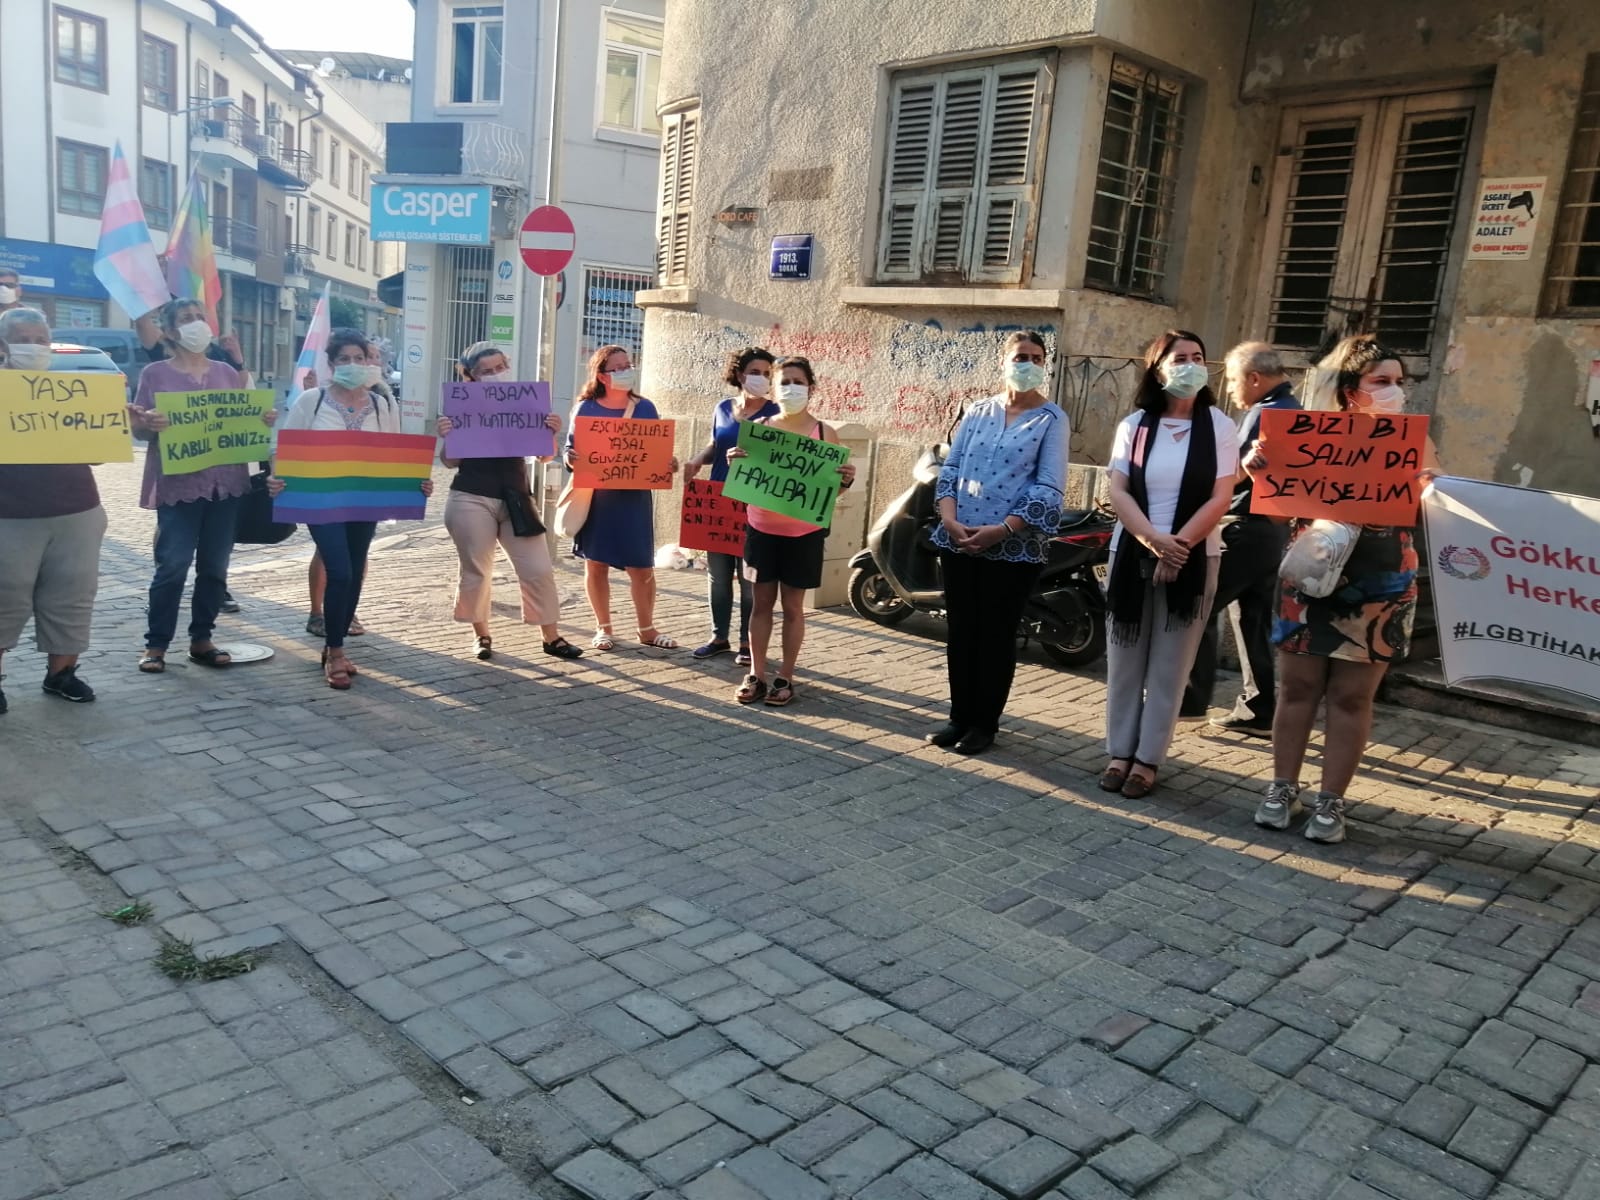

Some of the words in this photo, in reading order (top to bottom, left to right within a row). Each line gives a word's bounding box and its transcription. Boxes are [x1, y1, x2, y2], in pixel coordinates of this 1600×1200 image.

[383, 186, 478, 226] Casper
[1475, 227, 1514, 236] ADALET
[21, 375, 88, 402] YASA
[167, 437, 212, 460] KABUL
[608, 437, 645, 451] YASAL
[1384, 447, 1419, 470] DA
[1490, 535, 1600, 576] Gökku
[1506, 573, 1600, 616] Herke
